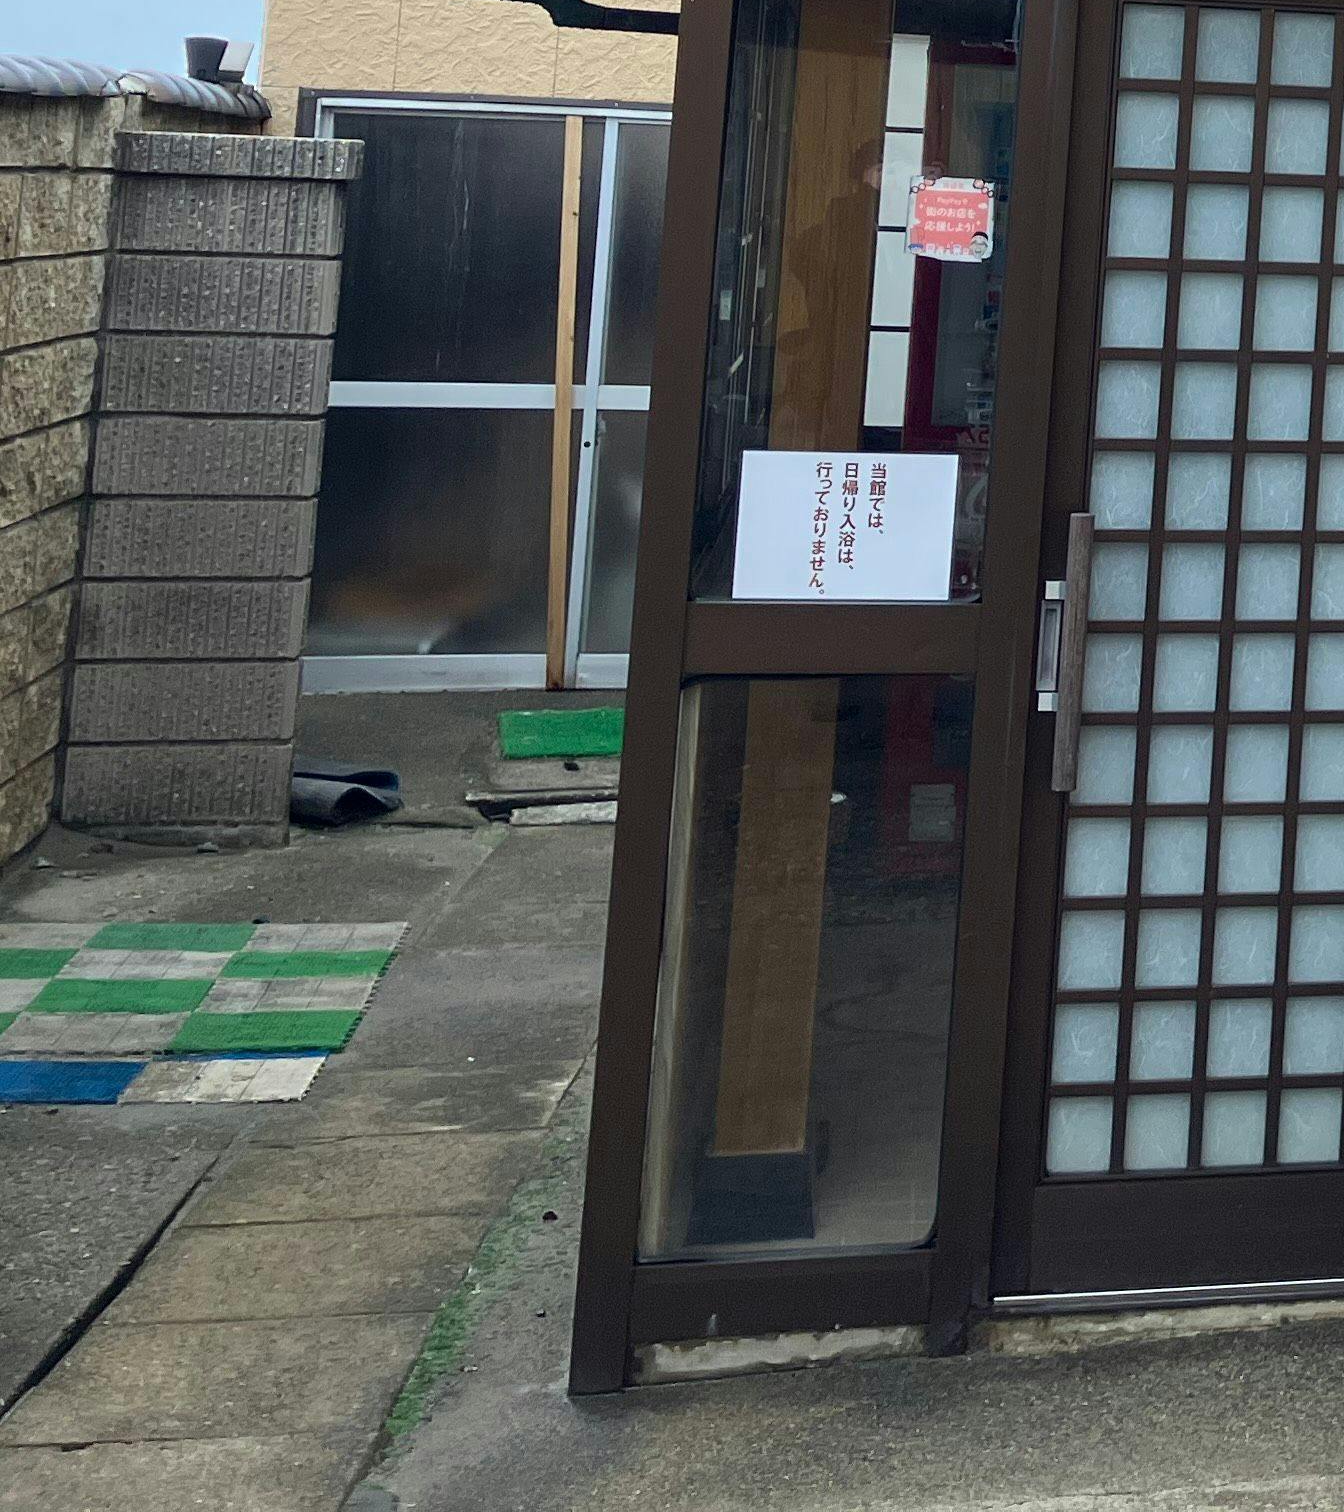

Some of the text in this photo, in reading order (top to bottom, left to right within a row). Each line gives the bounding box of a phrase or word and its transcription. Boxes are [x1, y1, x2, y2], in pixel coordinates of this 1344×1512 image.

[808, 461, 833, 595] 行っておりません。
[838, 462, 859, 570] 日帰り入浴は、
[868, 462, 887, 535] 当館では、
